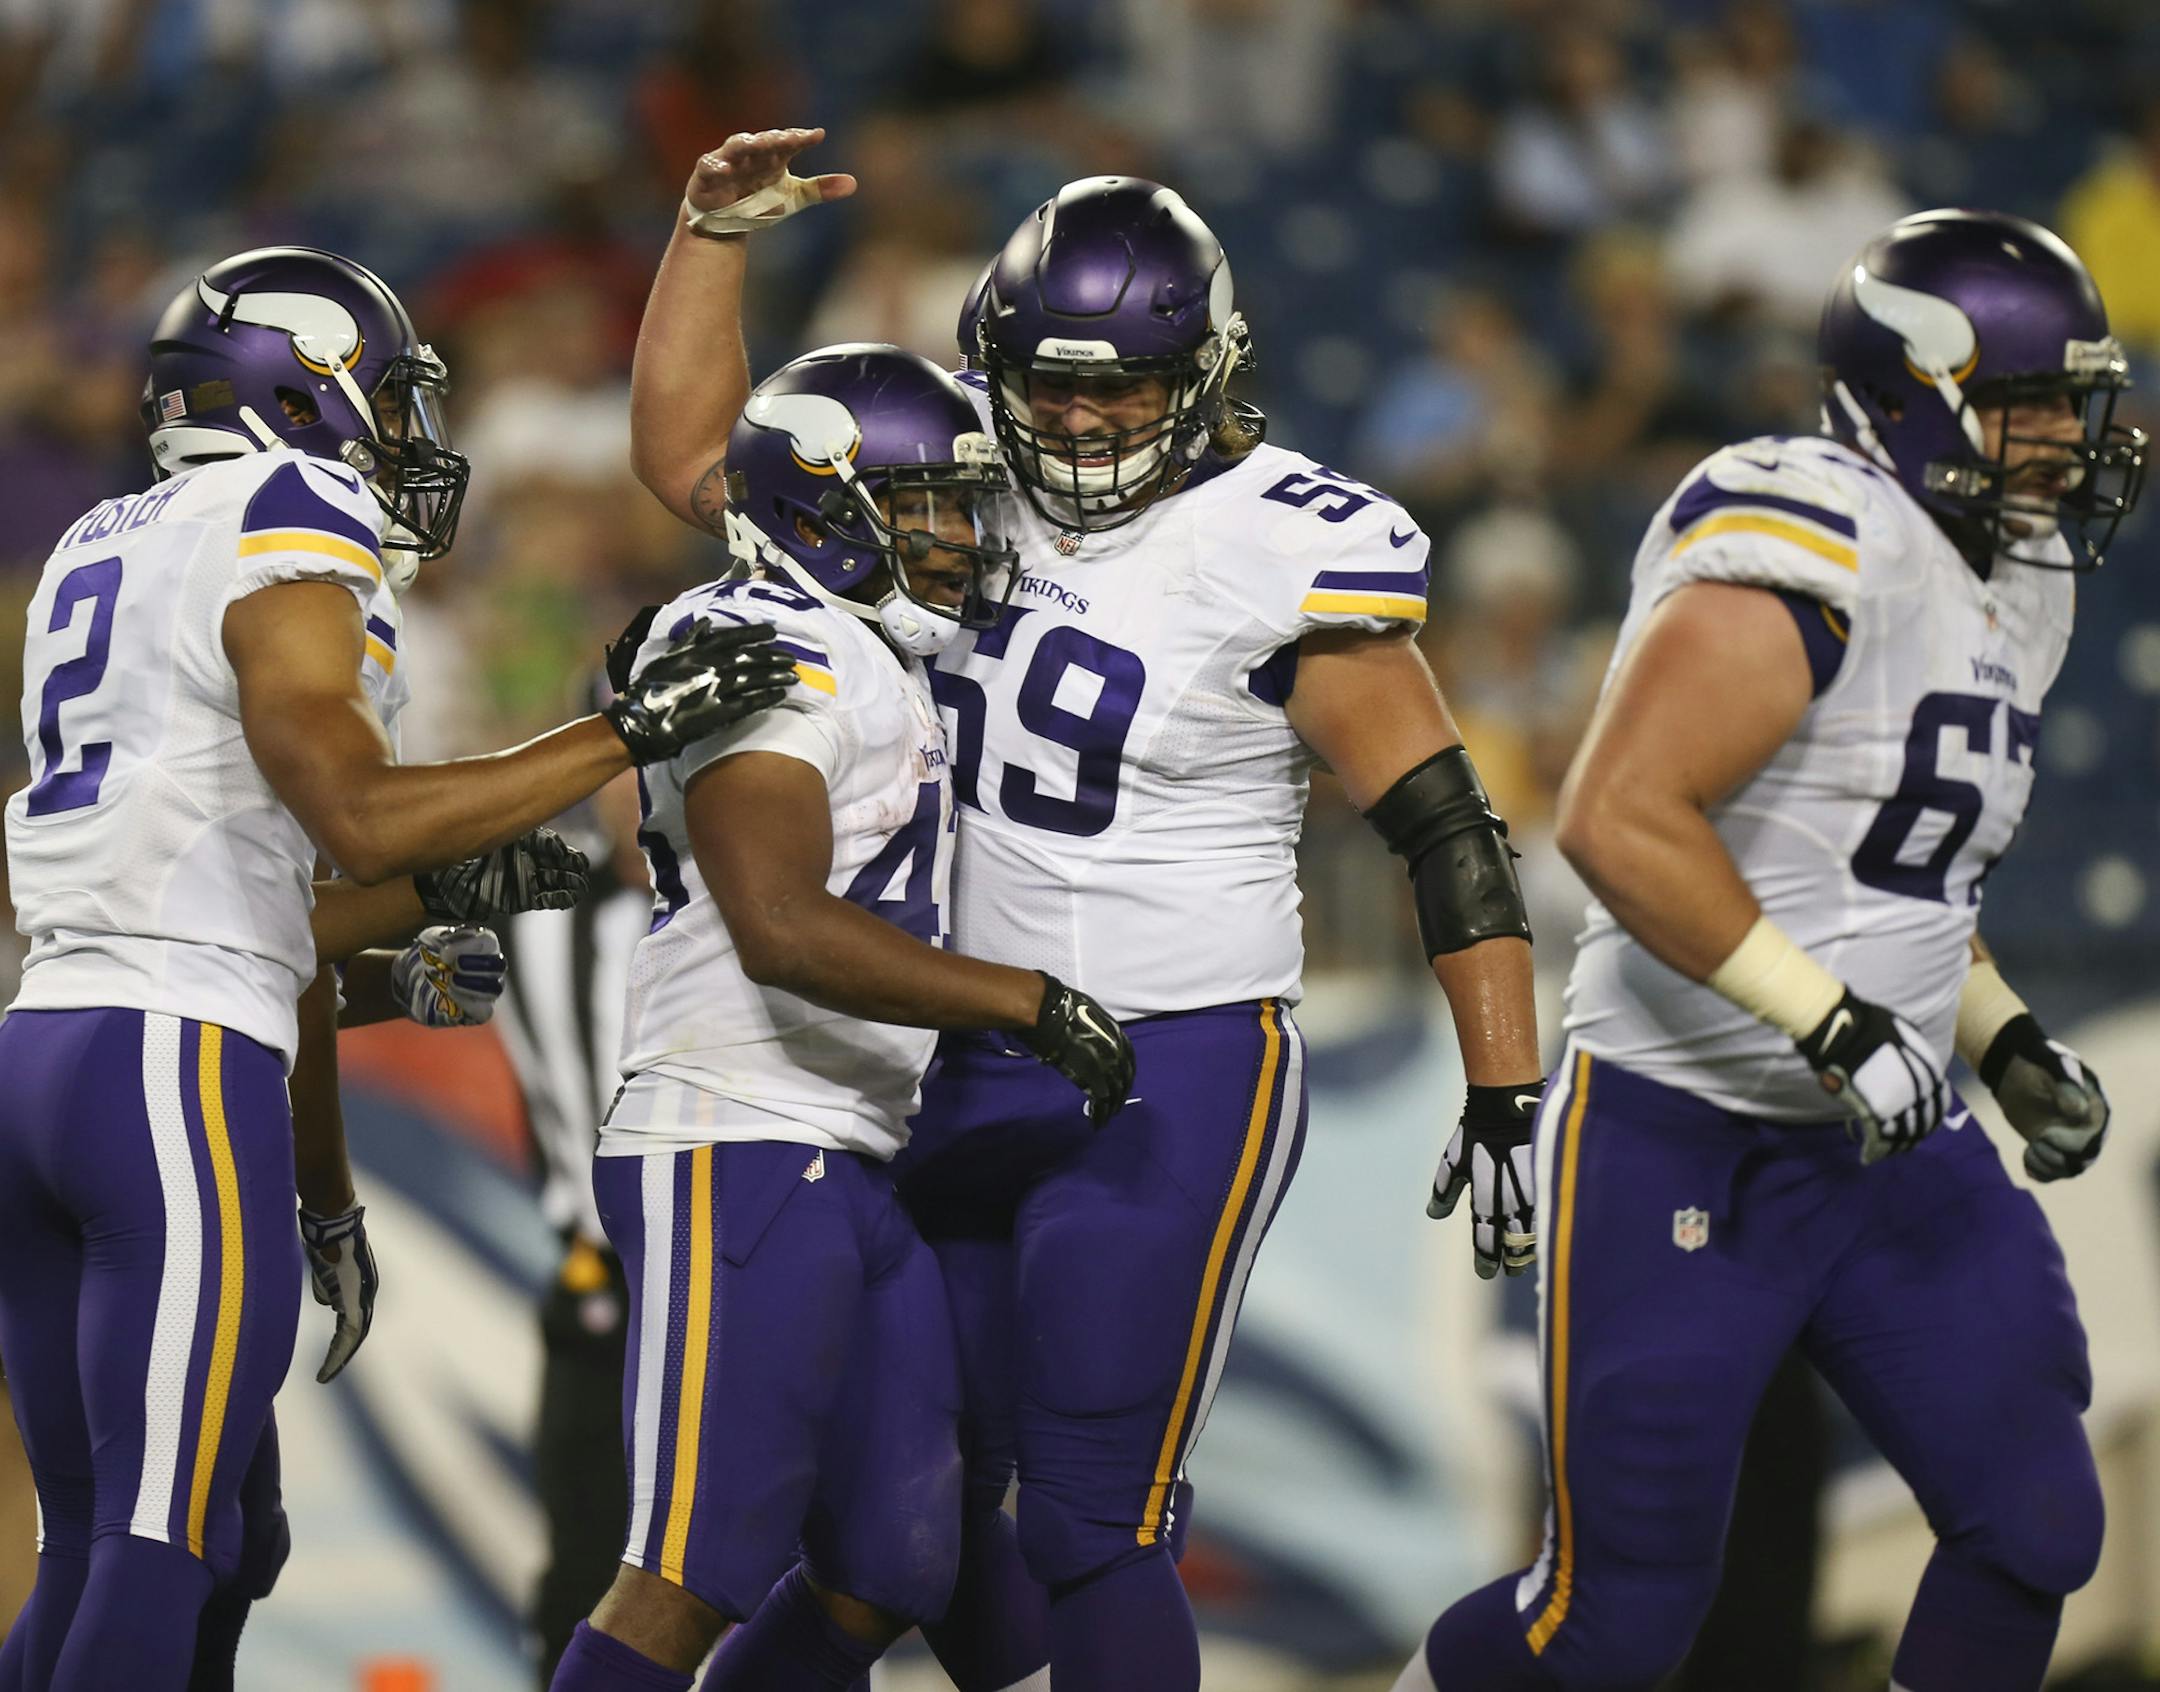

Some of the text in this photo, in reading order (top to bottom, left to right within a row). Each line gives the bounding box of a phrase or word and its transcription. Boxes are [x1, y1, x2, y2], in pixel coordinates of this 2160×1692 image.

[63, 478, 190, 549] FOSTER
[1057, 537, 1077, 553] NFL
[923, 605, 1146, 837] 59
[842, 782, 959, 949] 4
